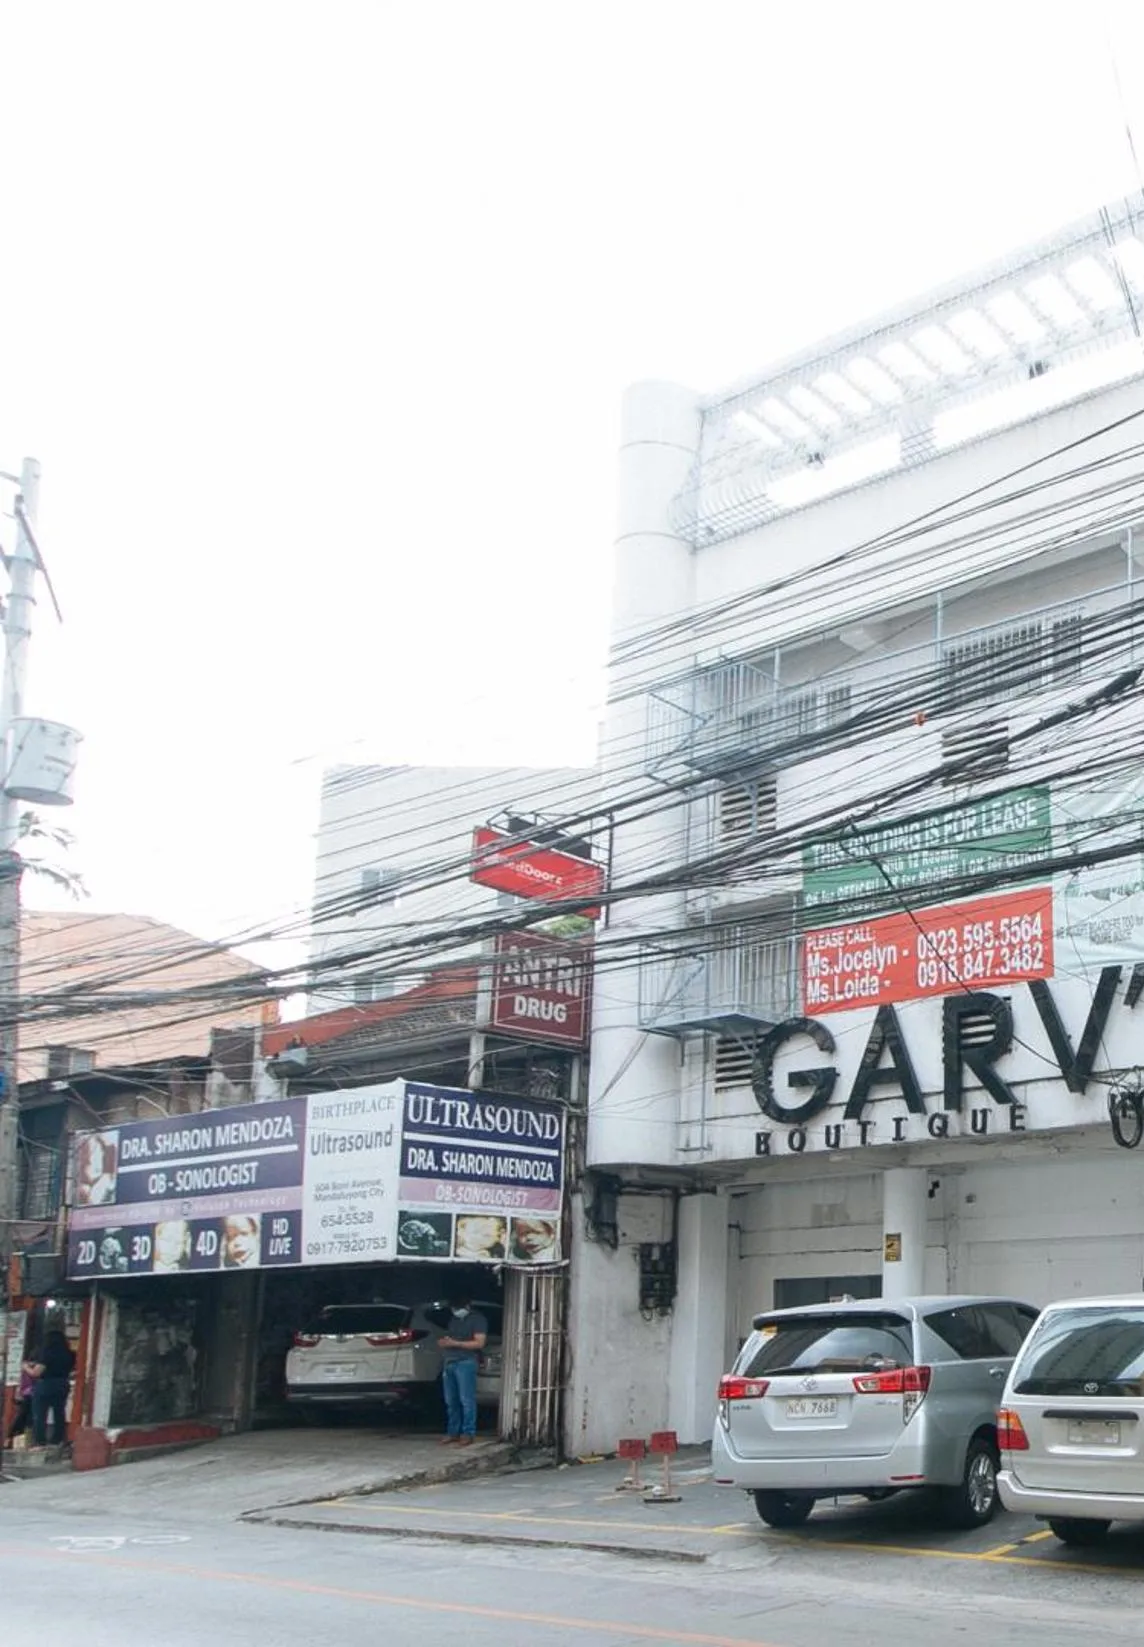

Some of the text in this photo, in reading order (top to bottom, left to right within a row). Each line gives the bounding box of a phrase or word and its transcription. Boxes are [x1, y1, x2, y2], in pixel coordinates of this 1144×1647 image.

[981, 798, 1038, 837] LEASE
[807, 926, 876, 951] PLEASE CALL:
[807, 944, 898, 978] Ms.Jocelyn
[917, 912, 1043, 959] 0923.595.5564
[807, 973, 880, 1005] Ms.Loida
[514, 995, 567, 1023] DRUG
[311, 1096, 396, 1120] BIRTHPLACE
[407, 1093, 560, 1141] ULTRASOUND
[121, 1115, 294, 1160] DRA. SHARON MENDOZA
[311, 1124, 393, 1156] Ultrasound
[755, 1104, 1028, 1156] BOUTIQUE
[175, 1162, 259, 1192] SONOLOGIST
[407, 1147, 555, 1182] DRA. SHARON MENDOZA
[434, 1184, 529, 1206] OB-SONOLOGIST
[272, 1217, 289, 1236] HD
[77, 1240, 96, 1265] 2D
[131, 1236, 151, 1261] 3D
[196, 1230, 218, 1256] 4D
[268, 1237, 293, 1256] LIVE
